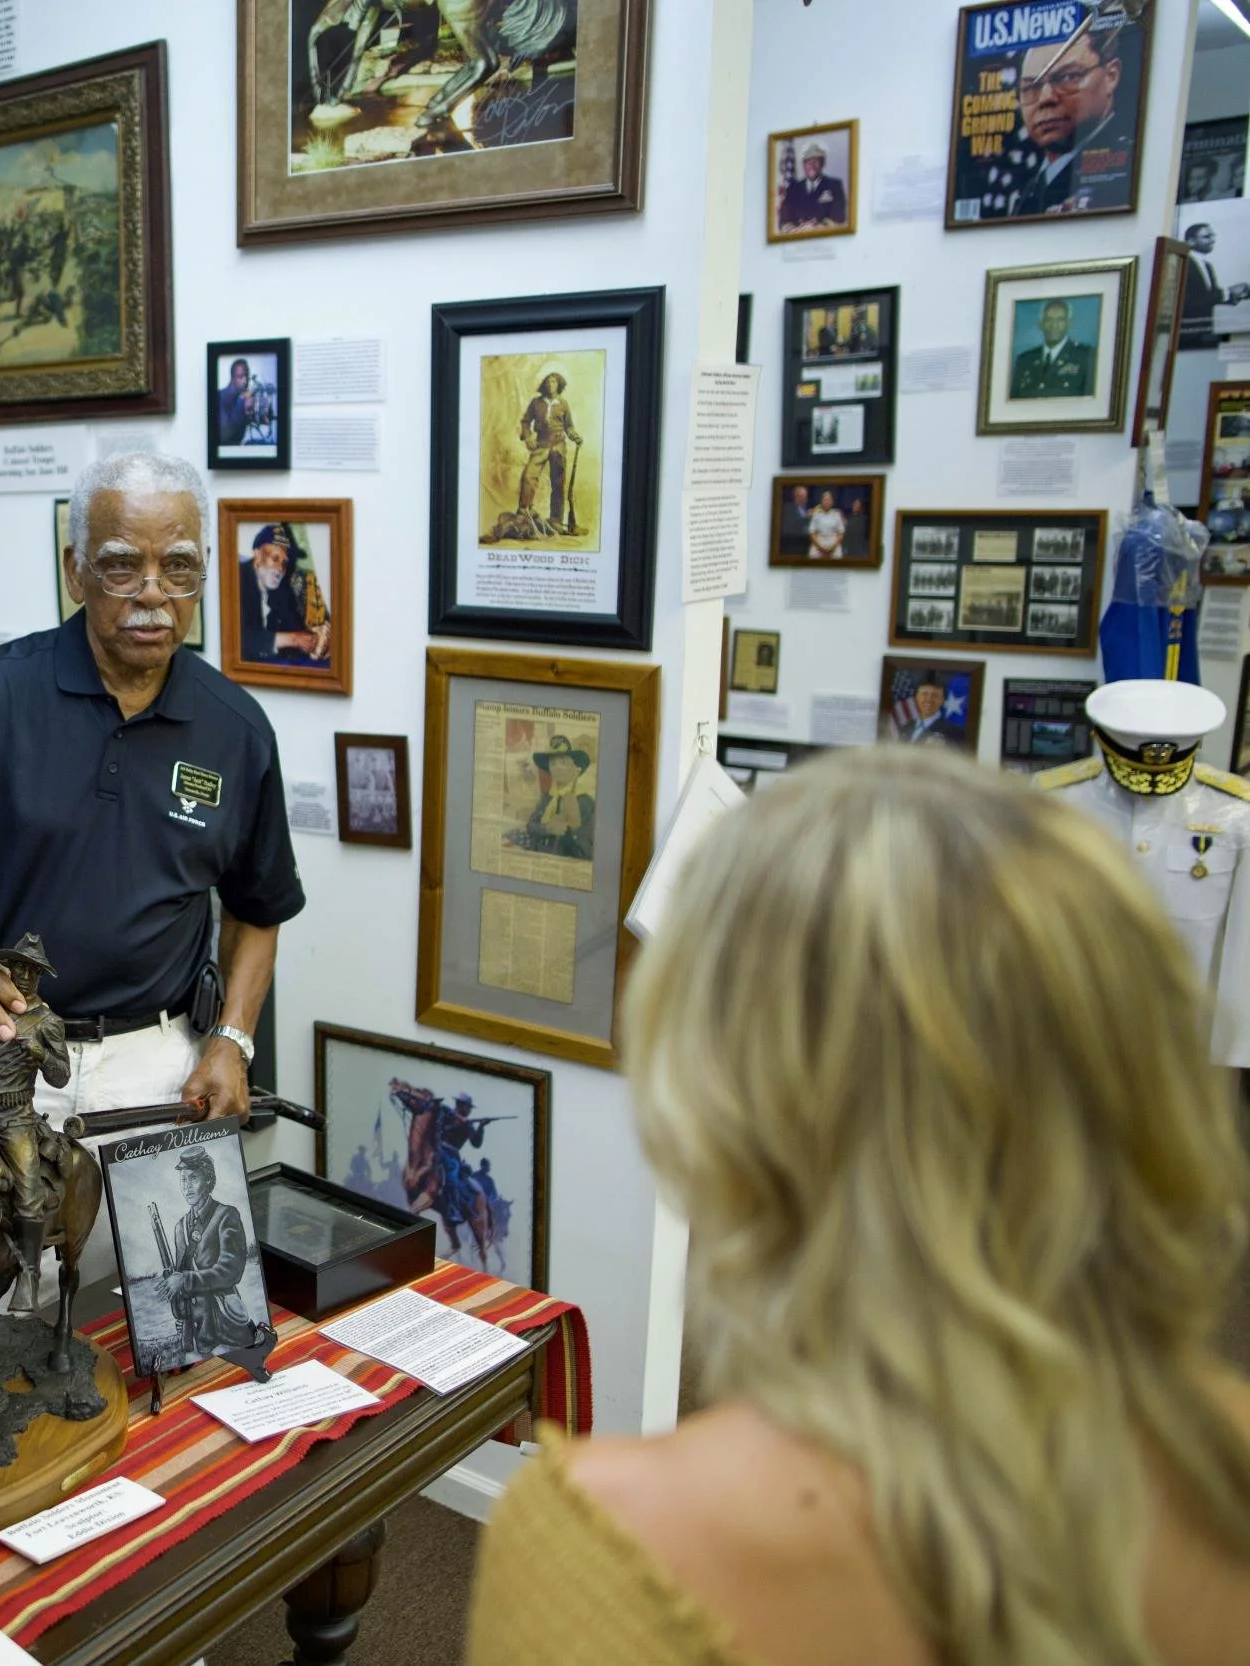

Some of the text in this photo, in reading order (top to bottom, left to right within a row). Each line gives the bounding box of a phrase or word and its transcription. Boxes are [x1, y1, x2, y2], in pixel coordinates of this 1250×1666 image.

[974, 5, 1076, 49] U.S.News
[978, 72, 1002, 92] THE
[963, 90, 1017, 116] COMING
[961, 112, 1015, 137] GROUND
[971, 134, 1003, 156] WAR
[562, 710, 596, 722] Soldiers
[115, 1127, 229, 1162] Cathay Williams
